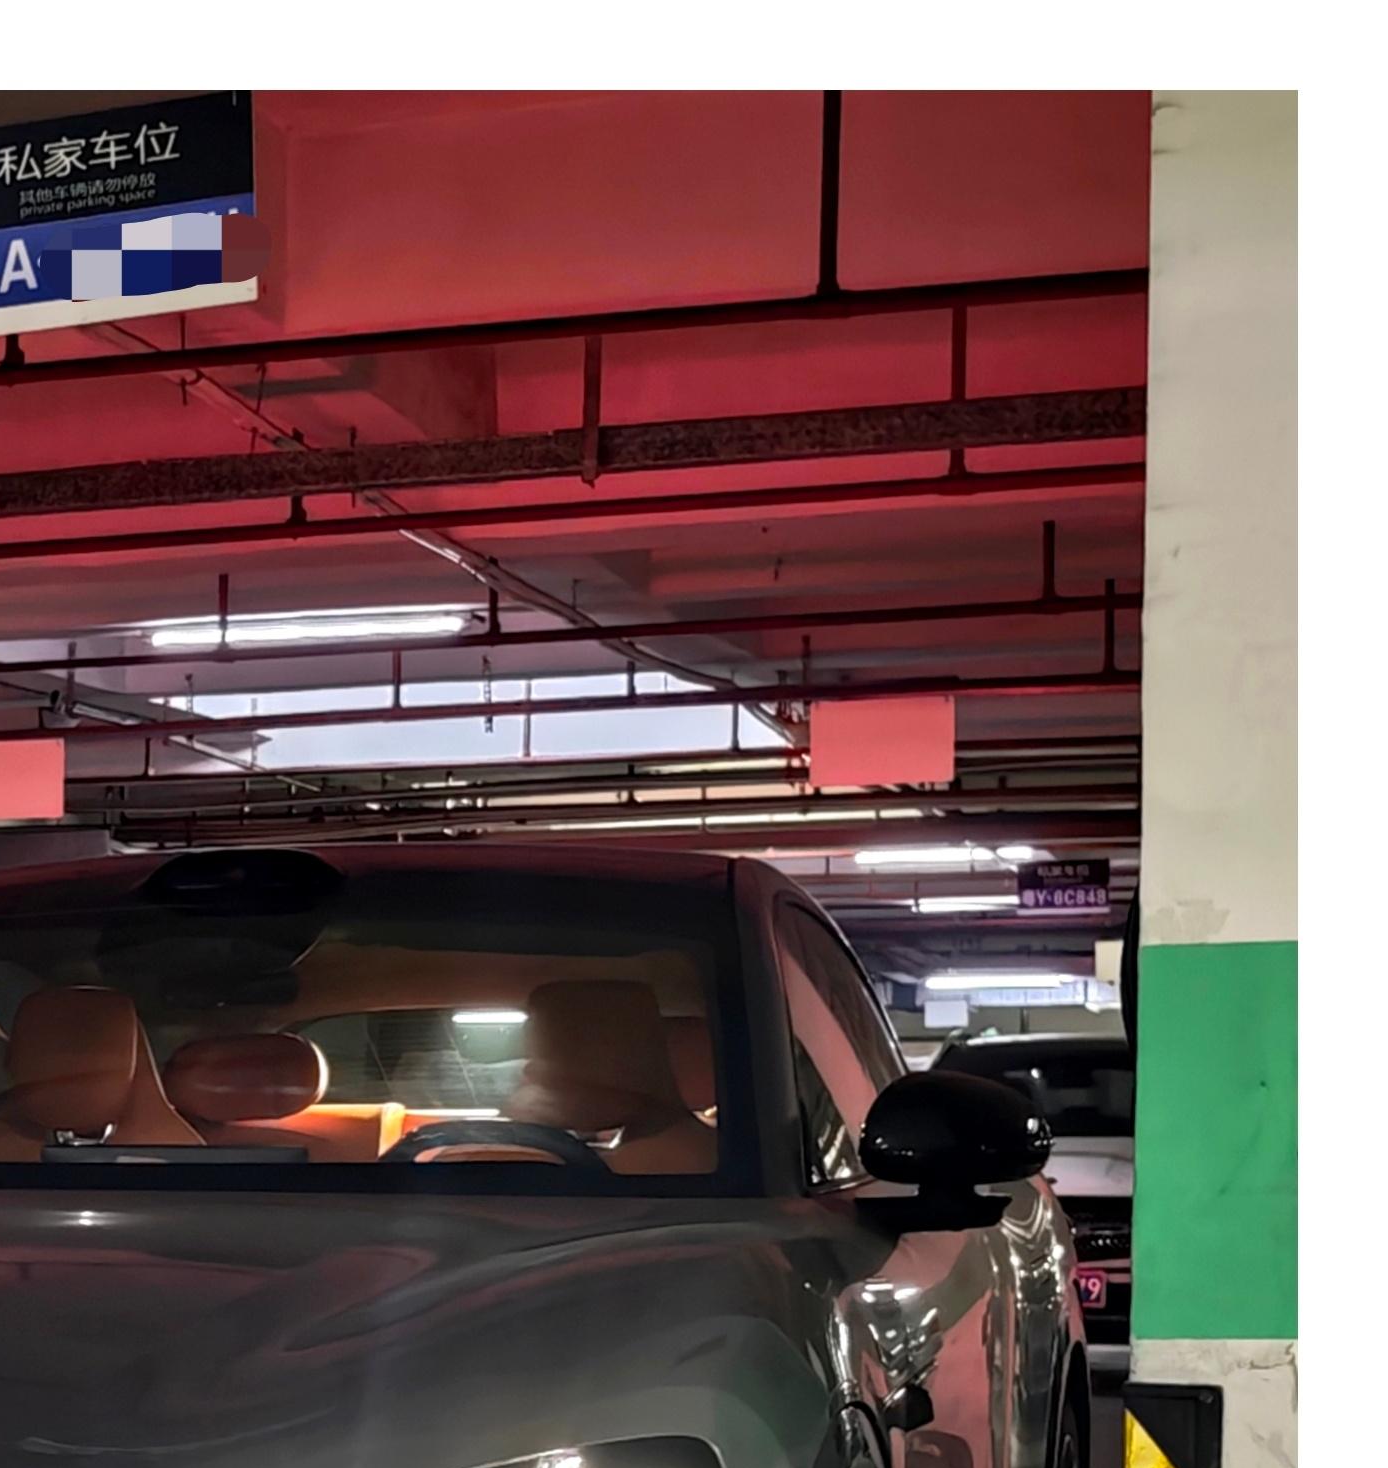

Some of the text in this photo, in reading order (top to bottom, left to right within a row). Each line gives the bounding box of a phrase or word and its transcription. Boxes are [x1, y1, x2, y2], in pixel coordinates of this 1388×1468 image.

[19, 187, 156, 219] private parking space
